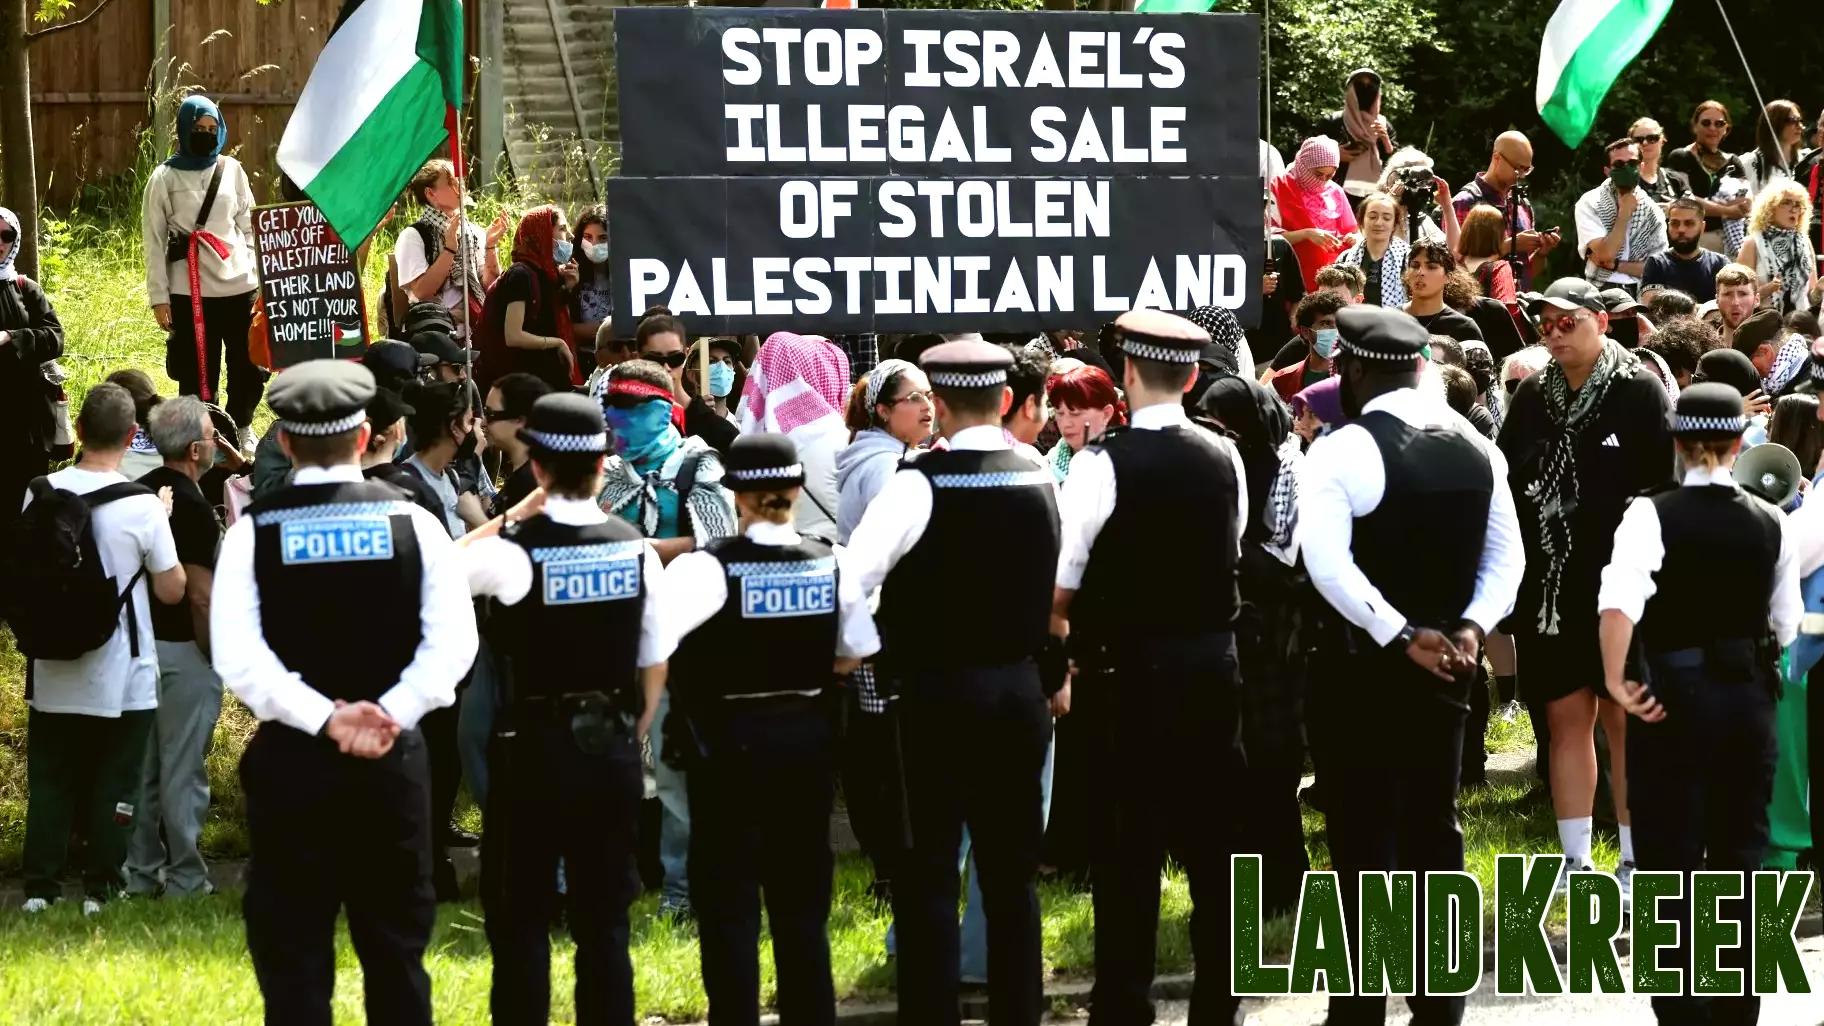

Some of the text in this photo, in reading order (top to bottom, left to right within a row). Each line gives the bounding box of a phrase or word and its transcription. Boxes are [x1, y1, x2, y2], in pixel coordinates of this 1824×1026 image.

[721, 27, 1186, 89] STOP ISRAEL'S
[724, 104, 1187, 163] ILLEGAL SALE
[259, 207, 289, 232] GET
[779, 180, 1110, 238] OF STOLEN
[259, 225, 325, 252] HANDS OFF
[262, 244, 349, 275] PALESTINE!!!
[265, 271, 355, 297] THEIR LAND
[629, 254, 1247, 317] PALESTINIAN LAND
[267, 298, 359, 319] IS NOT YOUR
[273, 319, 332, 342] HOME!!!
[287, 530, 388, 559] POLICE
[548, 570, 636, 600] POLICE
[747, 585, 832, 613] POLICE
